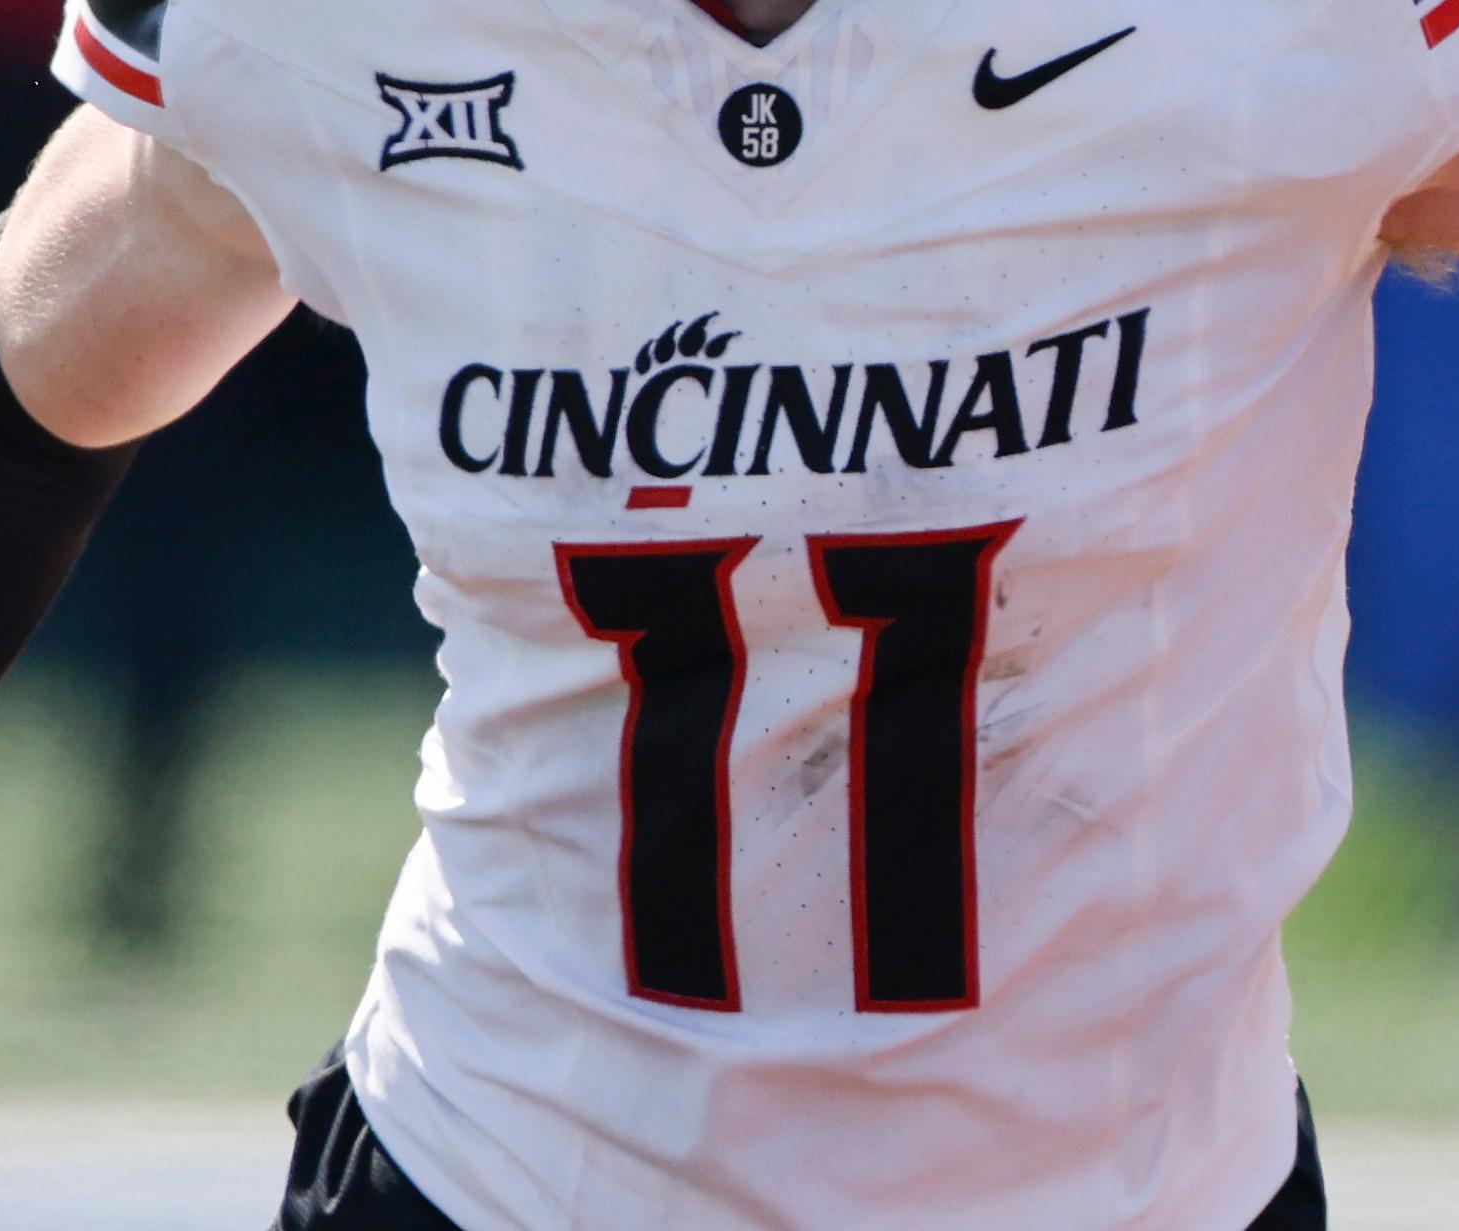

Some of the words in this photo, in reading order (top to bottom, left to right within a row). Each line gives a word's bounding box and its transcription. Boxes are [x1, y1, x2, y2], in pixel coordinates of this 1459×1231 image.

[381, 76, 517, 165] XII
[741, 93, 778, 125] JK
[741, 126, 780, 159] 58
[438, 308, 1151, 482] CINCINNATI
[551, 516, 1028, 1013] 11
